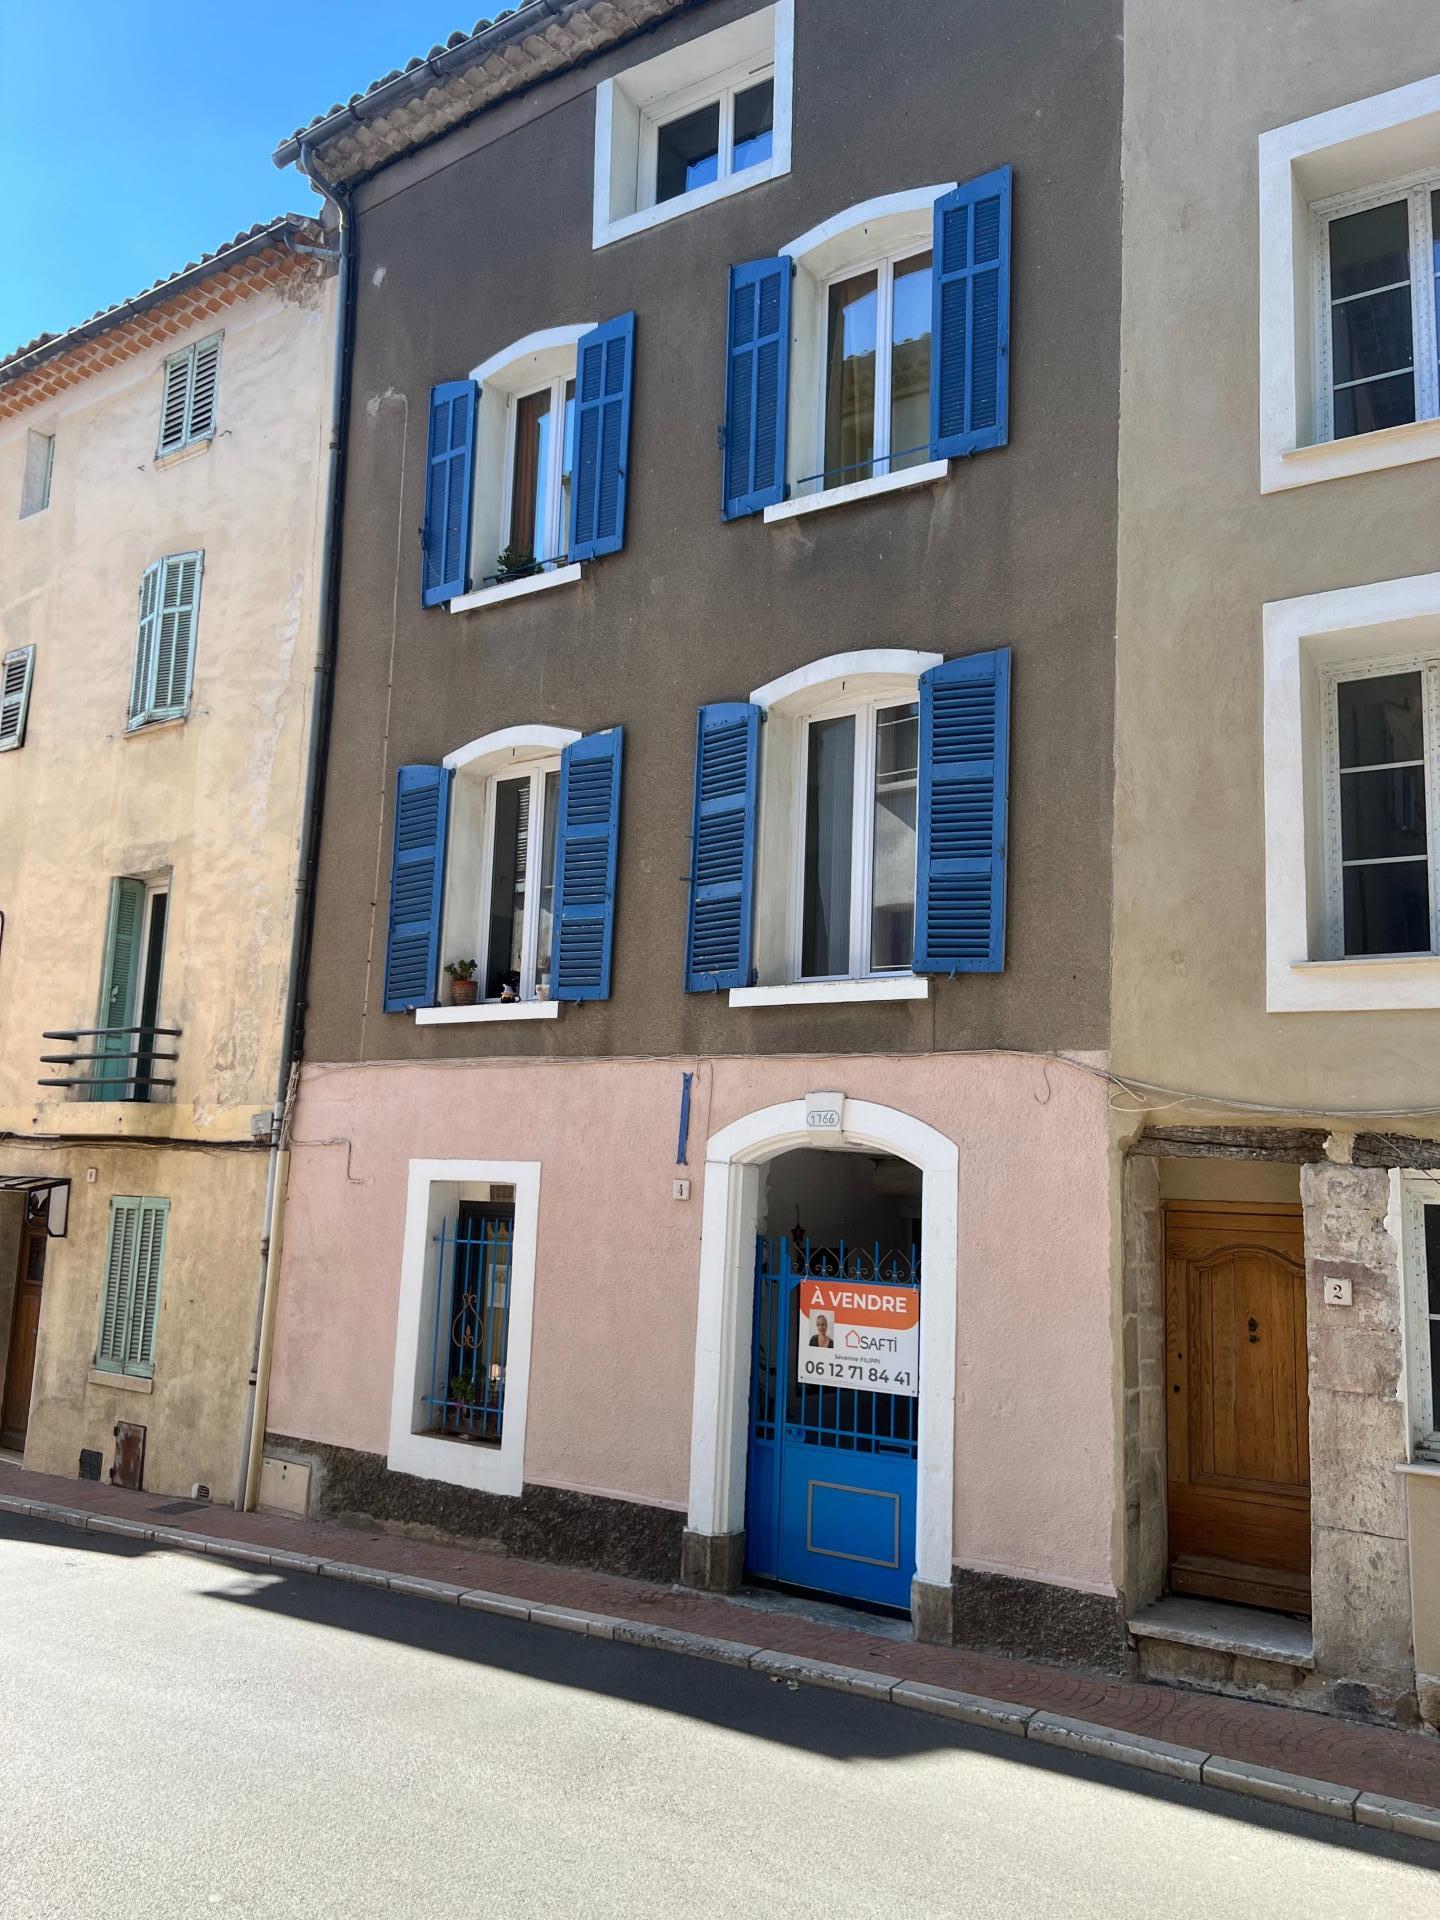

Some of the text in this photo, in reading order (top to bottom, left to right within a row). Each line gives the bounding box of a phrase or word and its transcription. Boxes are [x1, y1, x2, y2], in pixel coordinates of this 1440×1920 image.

[810, 1113, 835, 1126] 1766
[810, 1286, 907, 1313] À VENDRE
[1333, 1284, 1343, 1300] 2
[805, 1360, 825, 1375] 06
[828, 1363, 844, 1378] 12
[848, 1365, 863, 1380] 71
[868, 1367, 890, 1383] 84
[894, 1371, 911, 1386] 41
